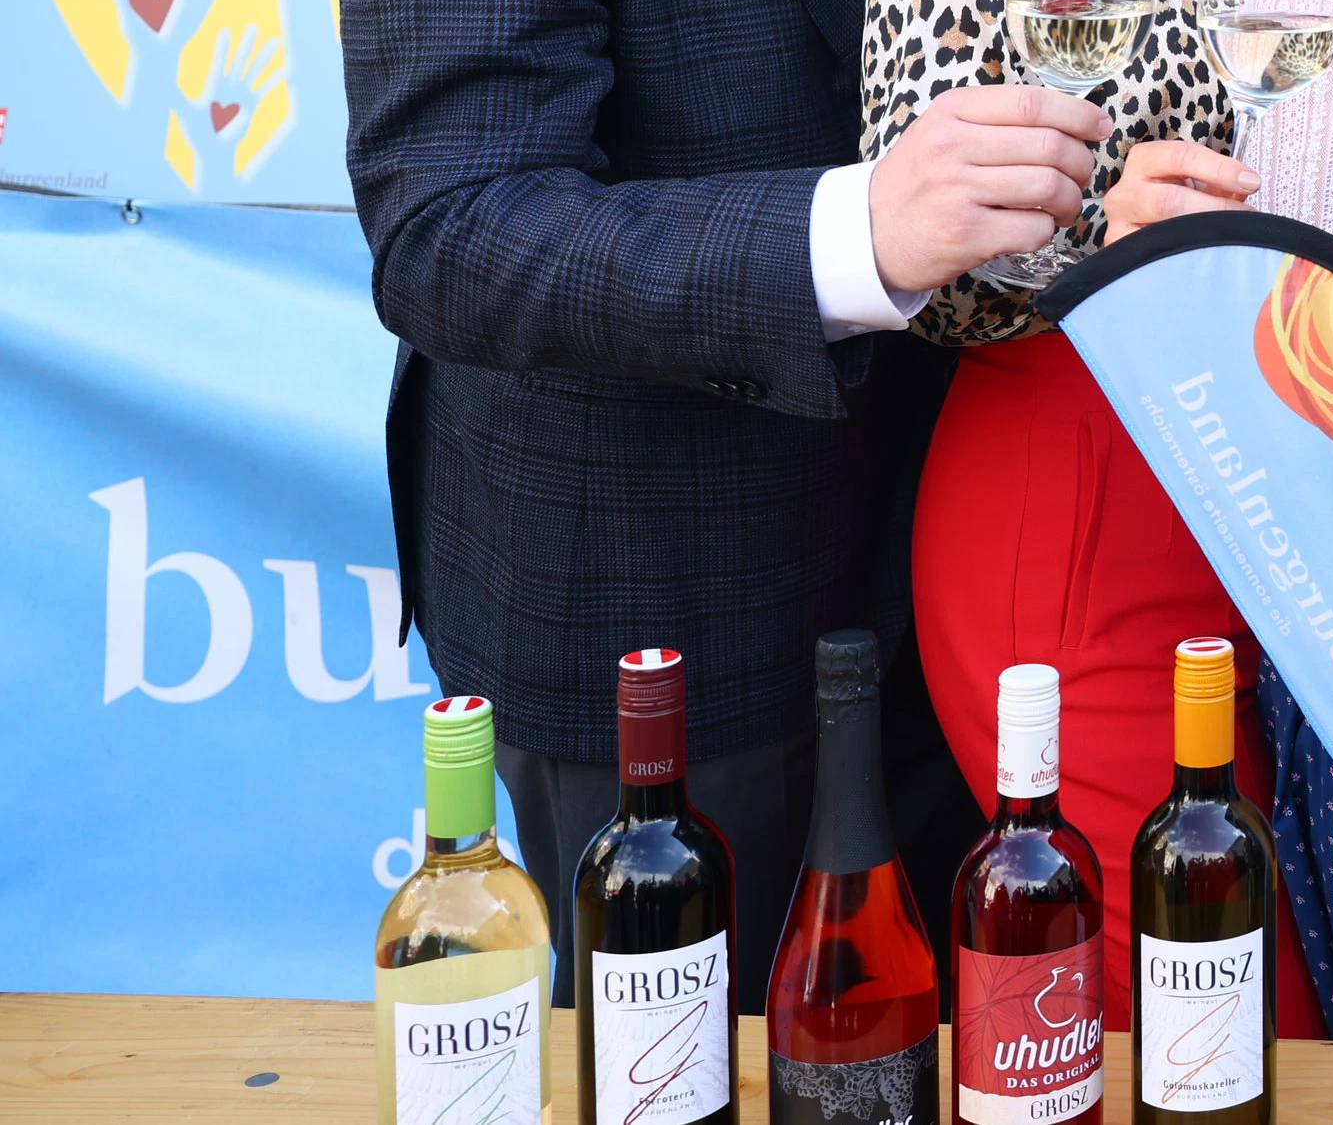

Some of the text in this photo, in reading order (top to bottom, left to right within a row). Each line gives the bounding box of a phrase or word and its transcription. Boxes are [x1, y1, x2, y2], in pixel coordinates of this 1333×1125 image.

[88, 476, 431, 705] bu
[628, 758, 674, 776] GROSZ
[604, 953, 719, 1004] GROSZ
[1150, 950, 1255, 992] GROSZ
[408, 1000, 531, 1057] GROSZ
[1006, 1055, 1101, 1089] DAS ORIGINAL
[1163, 1077, 1241, 1092] Goldmuskateller
[1030, 1085, 1089, 1120] GROSZ
